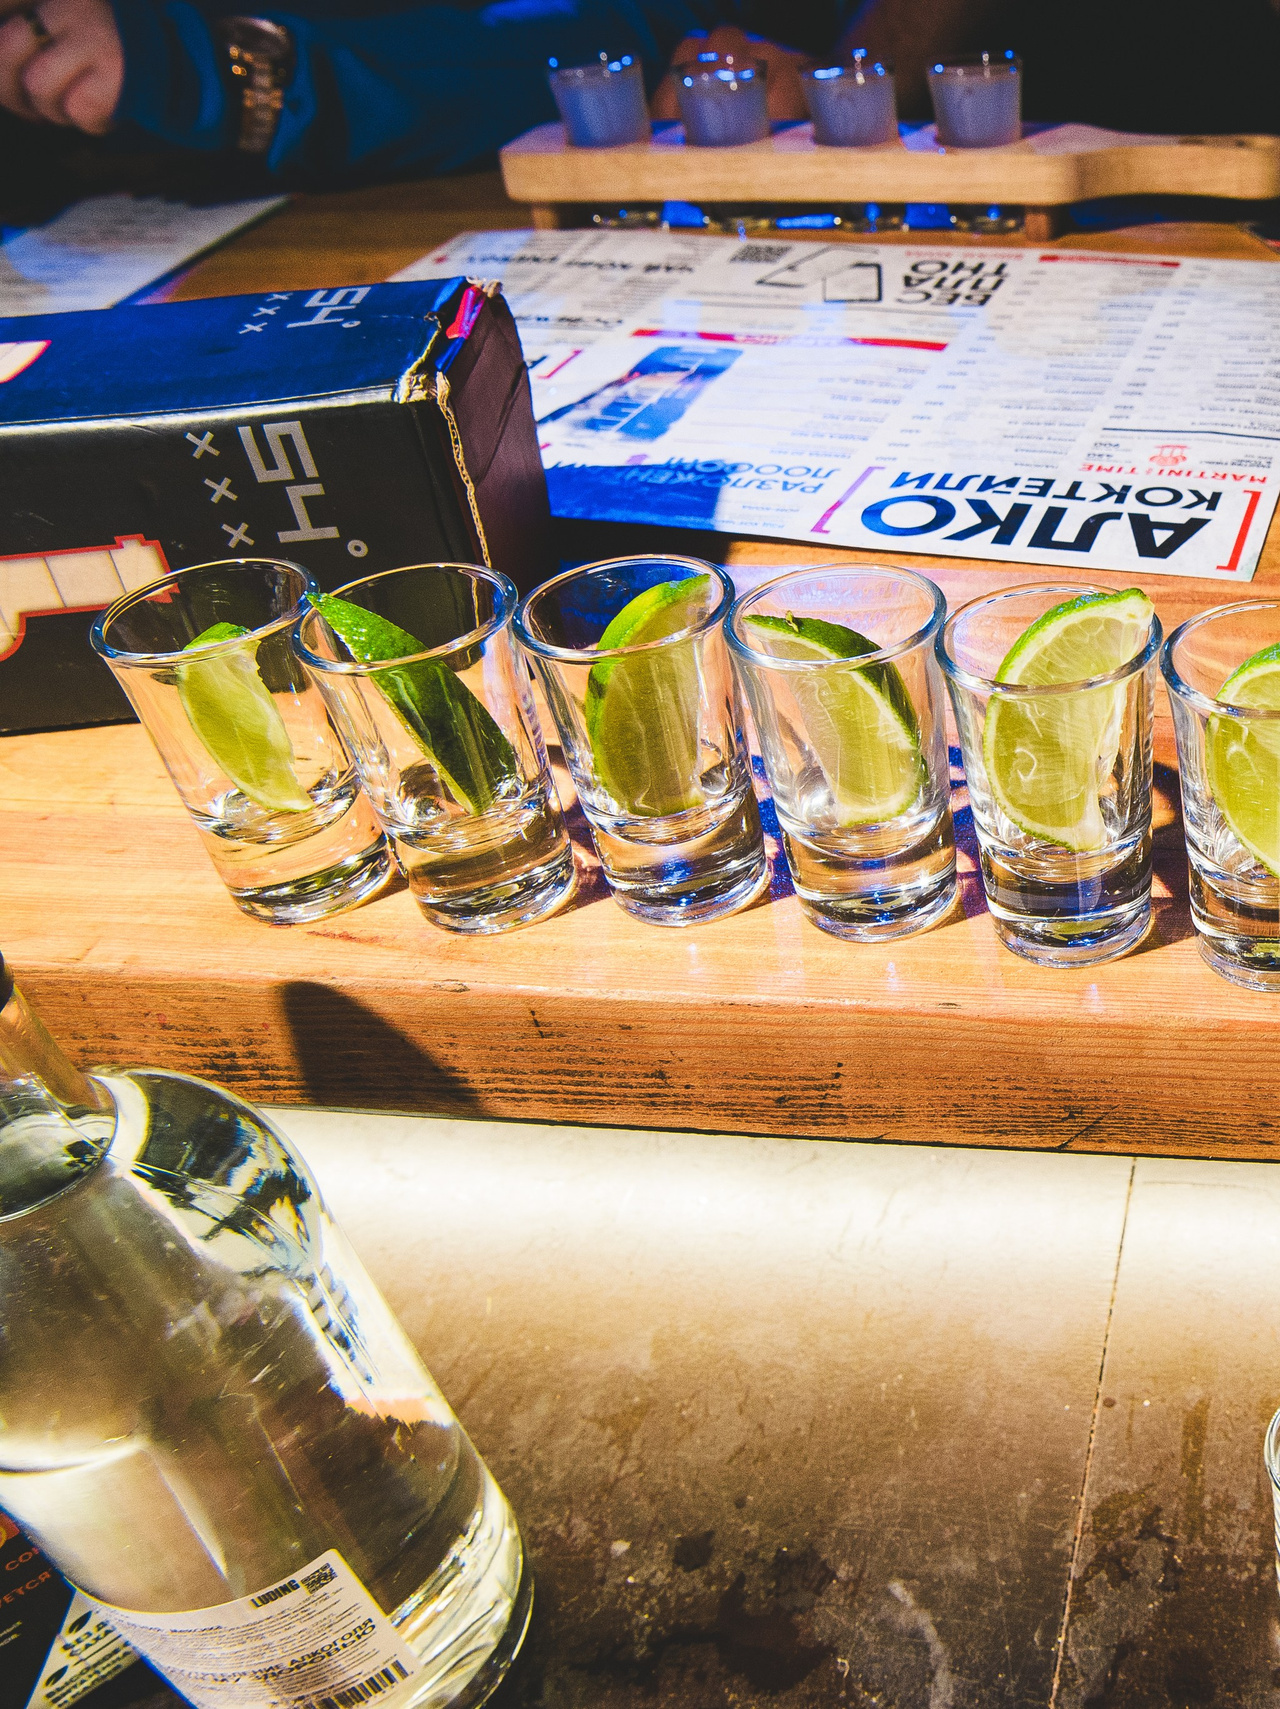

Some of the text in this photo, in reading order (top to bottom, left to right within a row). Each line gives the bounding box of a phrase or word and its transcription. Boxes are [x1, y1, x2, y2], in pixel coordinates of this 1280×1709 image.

[911, 260, 1008, 277] ТНО
[896, 290, 992, 307] БЕС
[1080, 463, 1268, 484] MARTINI TIME
[890, 472, 1223, 512] КОКТЕЙЛИ
[861, 494, 1213, 559] АЛКО
[251, 1579, 300, 1609] LUDING
[288, 1618, 374, 1668] АЛКОГОЛЯ
